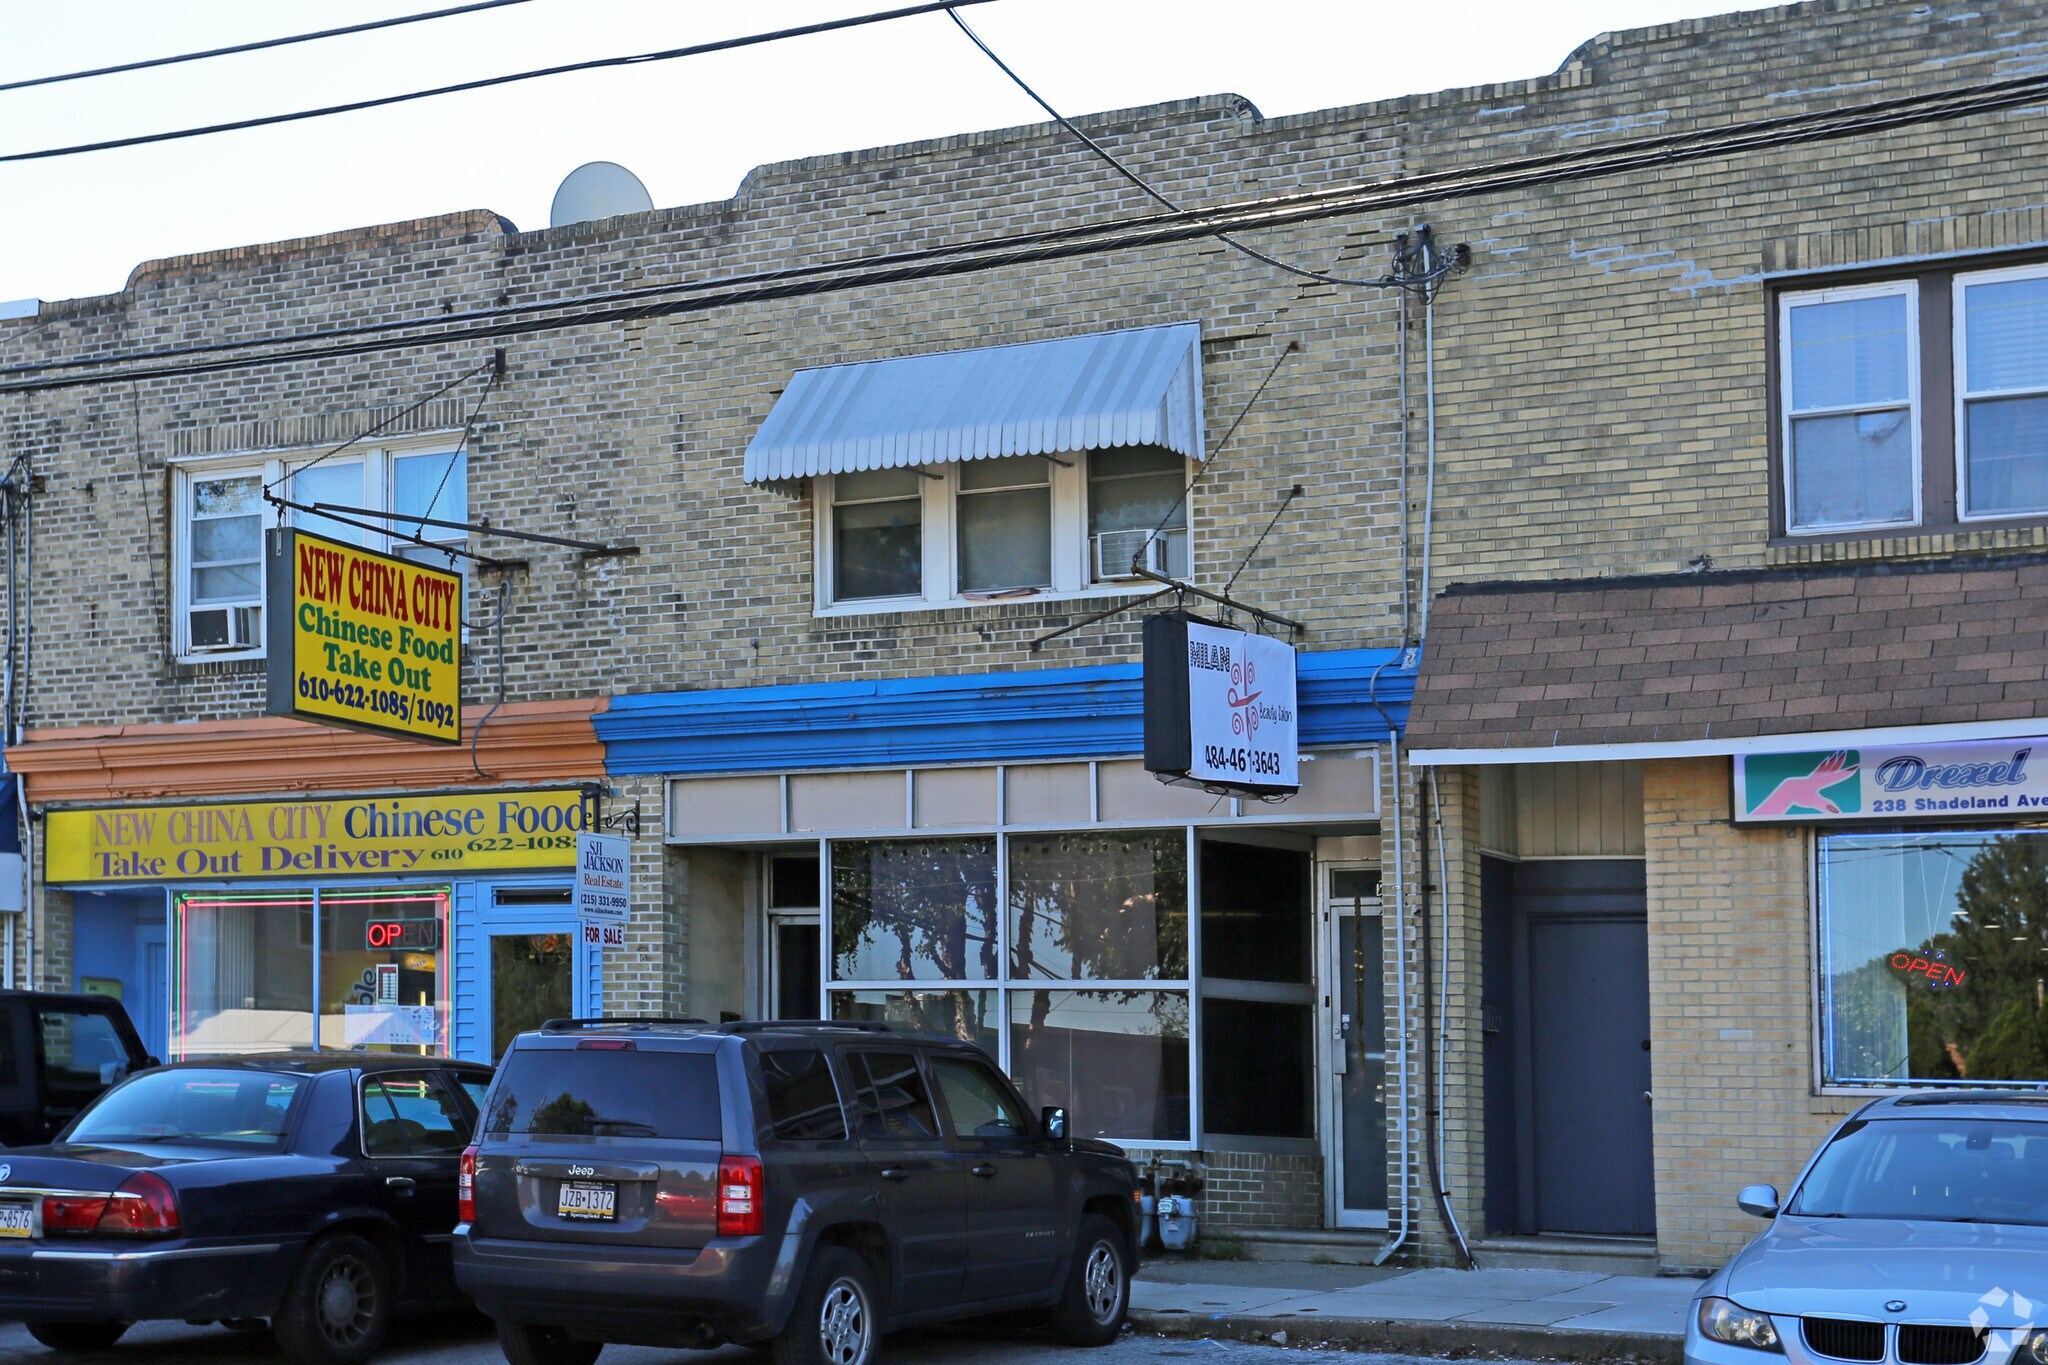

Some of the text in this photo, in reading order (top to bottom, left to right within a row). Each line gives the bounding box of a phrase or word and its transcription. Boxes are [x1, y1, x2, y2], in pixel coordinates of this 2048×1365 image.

[300, 543, 456, 632] NEW CHINA CITY
[298, 602, 454, 665] Chinese Food
[323, 642, 432, 692] Take Out
[1189, 640, 1231, 673] MILAN
[1874, 746, 2033, 793] Drexel
[1872, 799, 1907, 813] 238
[1915, 795, 2010, 811] Shadeland
[94, 795, 588, 847] NEW CHINA CITY Chinese Food
[94, 850, 166, 878] Take
[175, 847, 243, 876] Out
[261, 842, 427, 873] Delivery
[430, 847, 464, 862] 610
[589, 840, 603, 857] SJI
[583, 851, 624, 874] JACKSON
[583, 873, 624, 890] Real Estate
[580, 893, 627, 908] (215) 331-9950
[368, 922, 434, 947] OPEN
[585, 926, 623, 945] FOR SALE
[1890, 953, 1967, 986] OPEN
[568, 1164, 595, 1176] Jeep
[1025, 1230, 1055, 1238] PATRIOT
